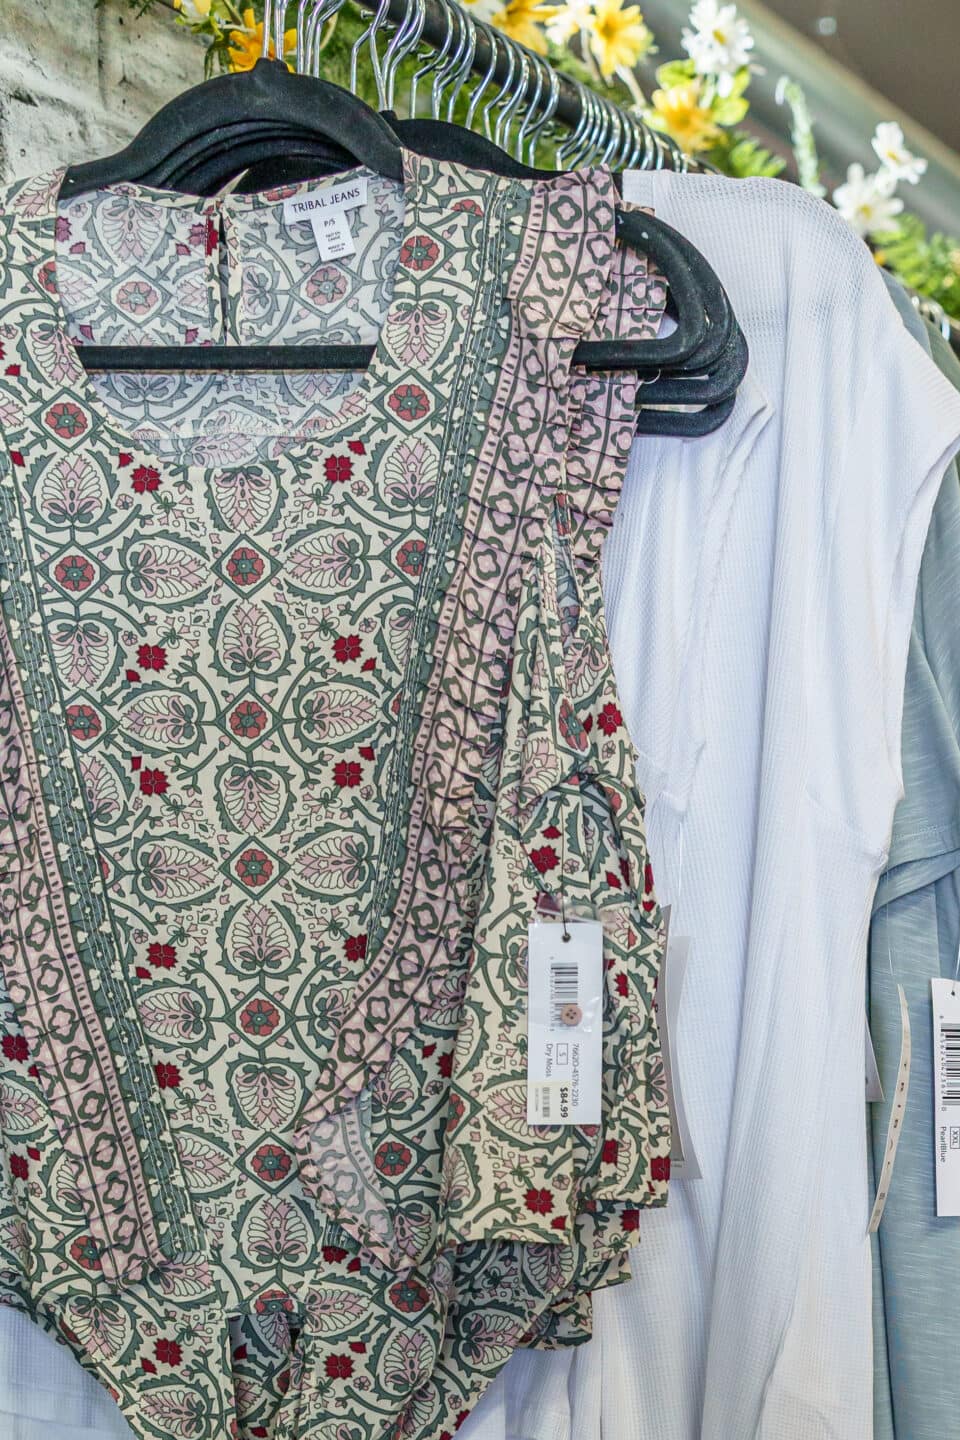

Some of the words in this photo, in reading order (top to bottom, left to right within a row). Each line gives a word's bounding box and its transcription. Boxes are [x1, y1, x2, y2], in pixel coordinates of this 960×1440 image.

[292, 198, 328, 213] TRIBAL
[330, 188, 360, 205] JEANS
[545, 1043, 553, 1057] Dry
[560, 1087, 569, 1118] $84.99
[939, 1126, 948, 1163] PearlBlue
